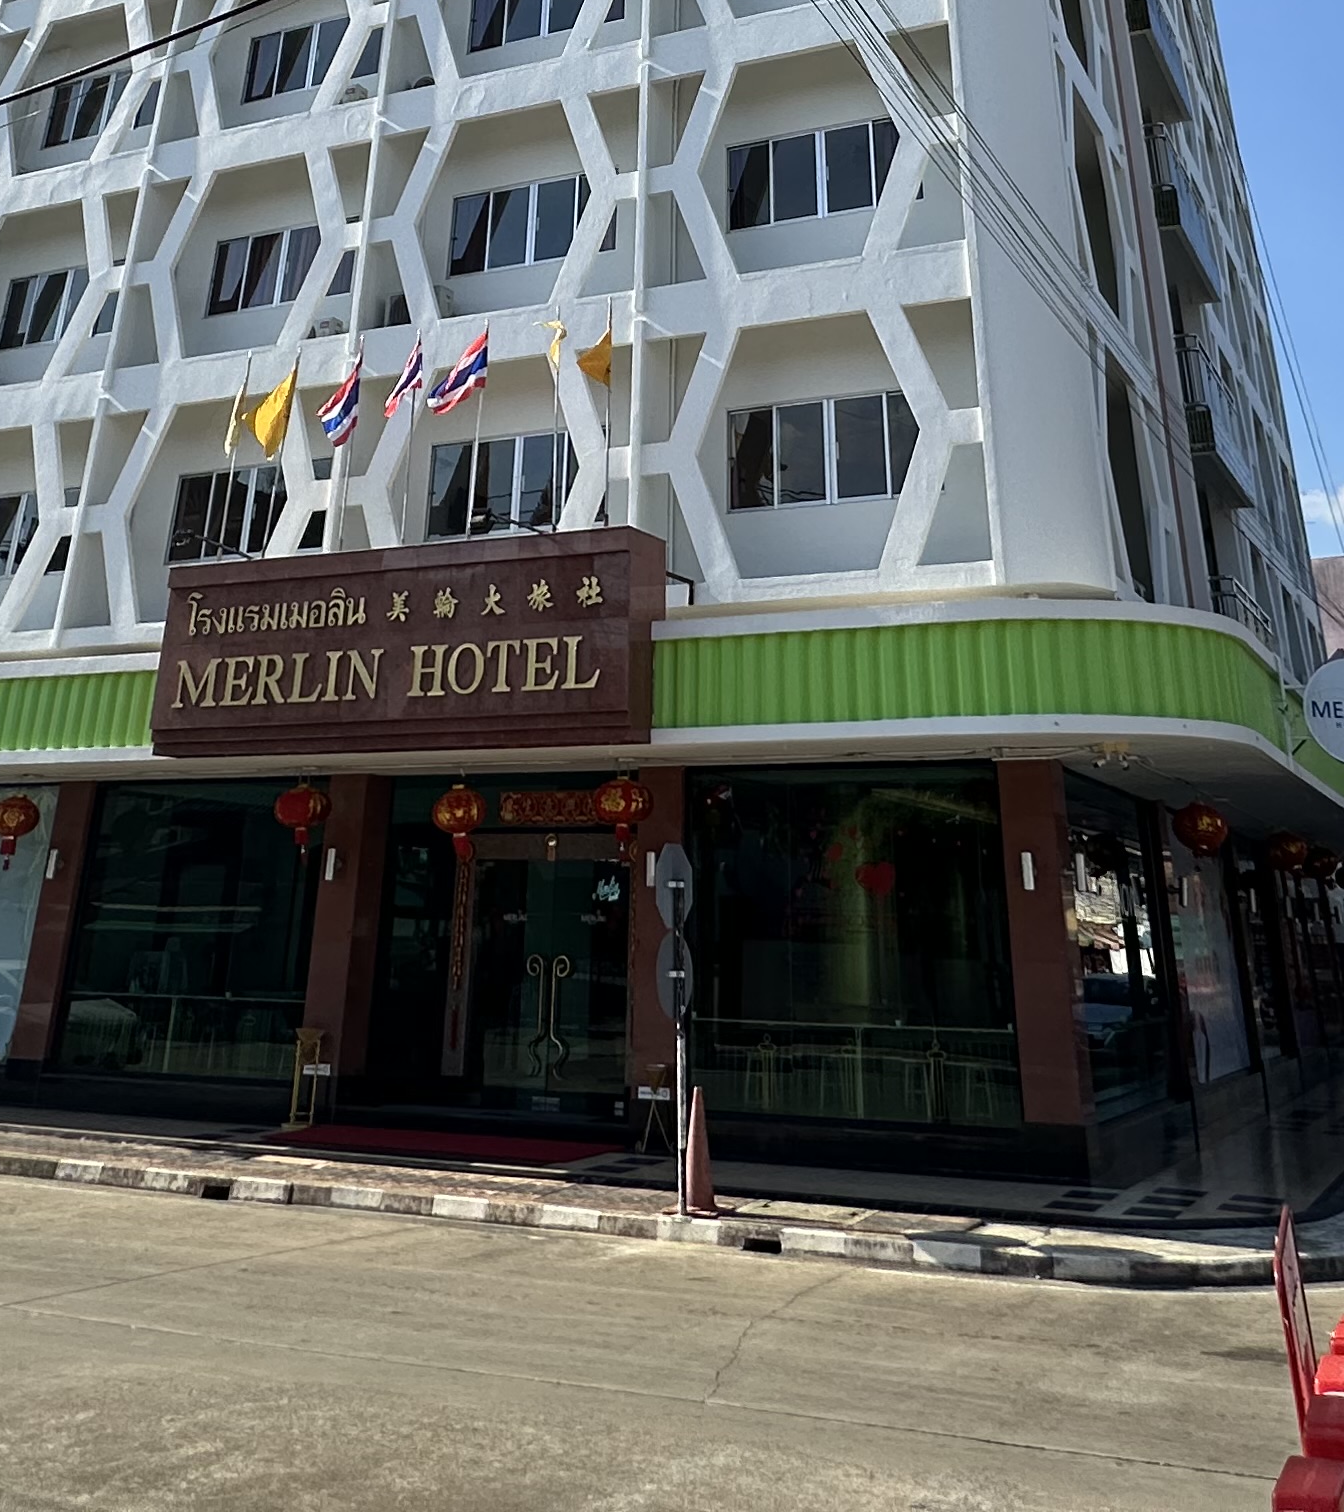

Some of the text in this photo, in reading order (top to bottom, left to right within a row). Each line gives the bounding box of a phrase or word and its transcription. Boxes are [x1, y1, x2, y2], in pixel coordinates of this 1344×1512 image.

[186, 587, 367, 637] โรงแรมเมอลิน
[170, 635, 601, 709] MERLIN HOTEL
